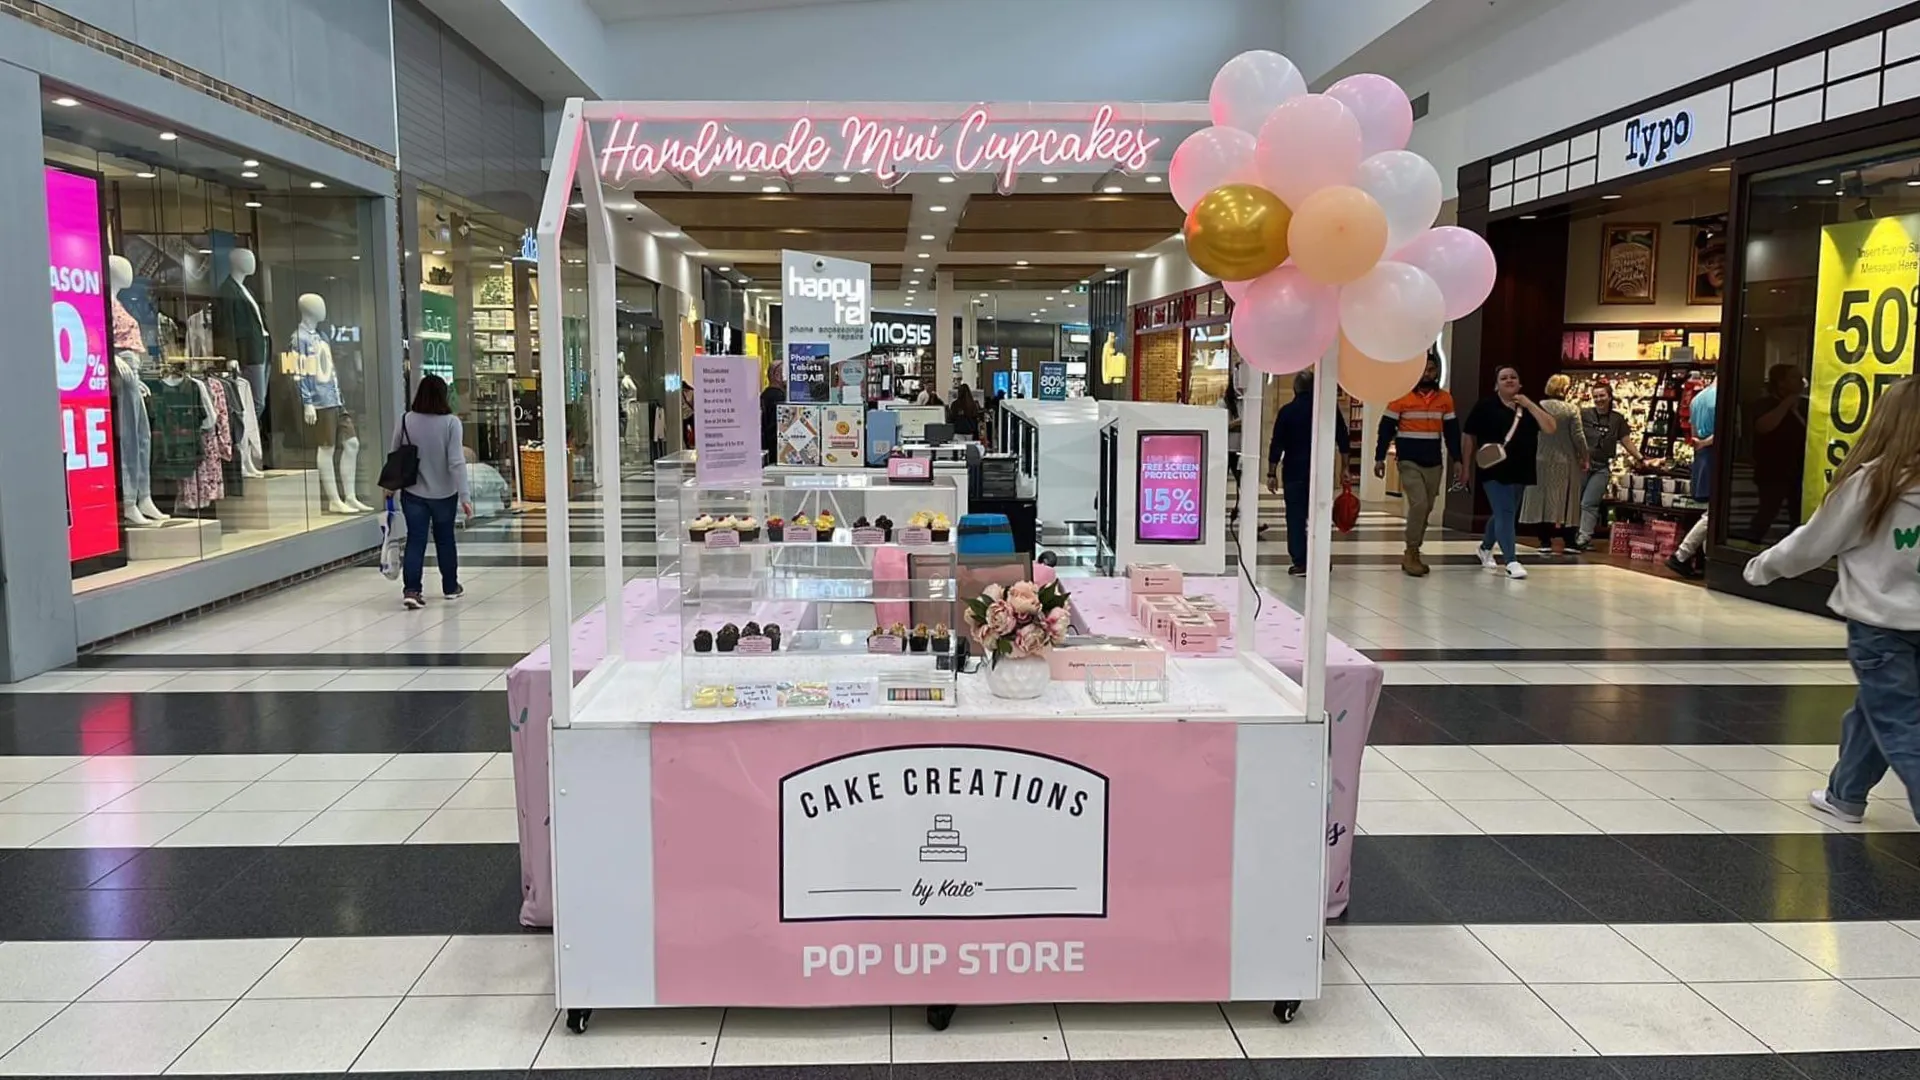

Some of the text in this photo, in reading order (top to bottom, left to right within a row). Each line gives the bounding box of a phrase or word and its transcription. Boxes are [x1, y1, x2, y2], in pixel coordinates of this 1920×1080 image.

[600, 105, 1160, 187] Handmade Mini Cupcakes
[1625, 110, 1689, 167] Typo
[789, 266, 865, 303] happy
[870, 321, 932, 345] MOSIS
[790, 353, 816, 361] Phone
[791, 363, 822, 371] Tablets
[790, 373, 825, 382] REPAIR
[1040, 375, 1065, 388] 80%
[1043, 387, 1062, 395] OFF
[1144, 471, 1197, 479] PROTECTOR
[1164, 463, 1200, 471] SCREEN
[1144, 488, 1195, 511] 15%
[1141, 513, 1168, 524] OFF
[800, 767, 1089, 819] CAKE CREATIONS
[911, 878, 934, 906] by
[803, 940, 1085, 977] POP UP STORE
